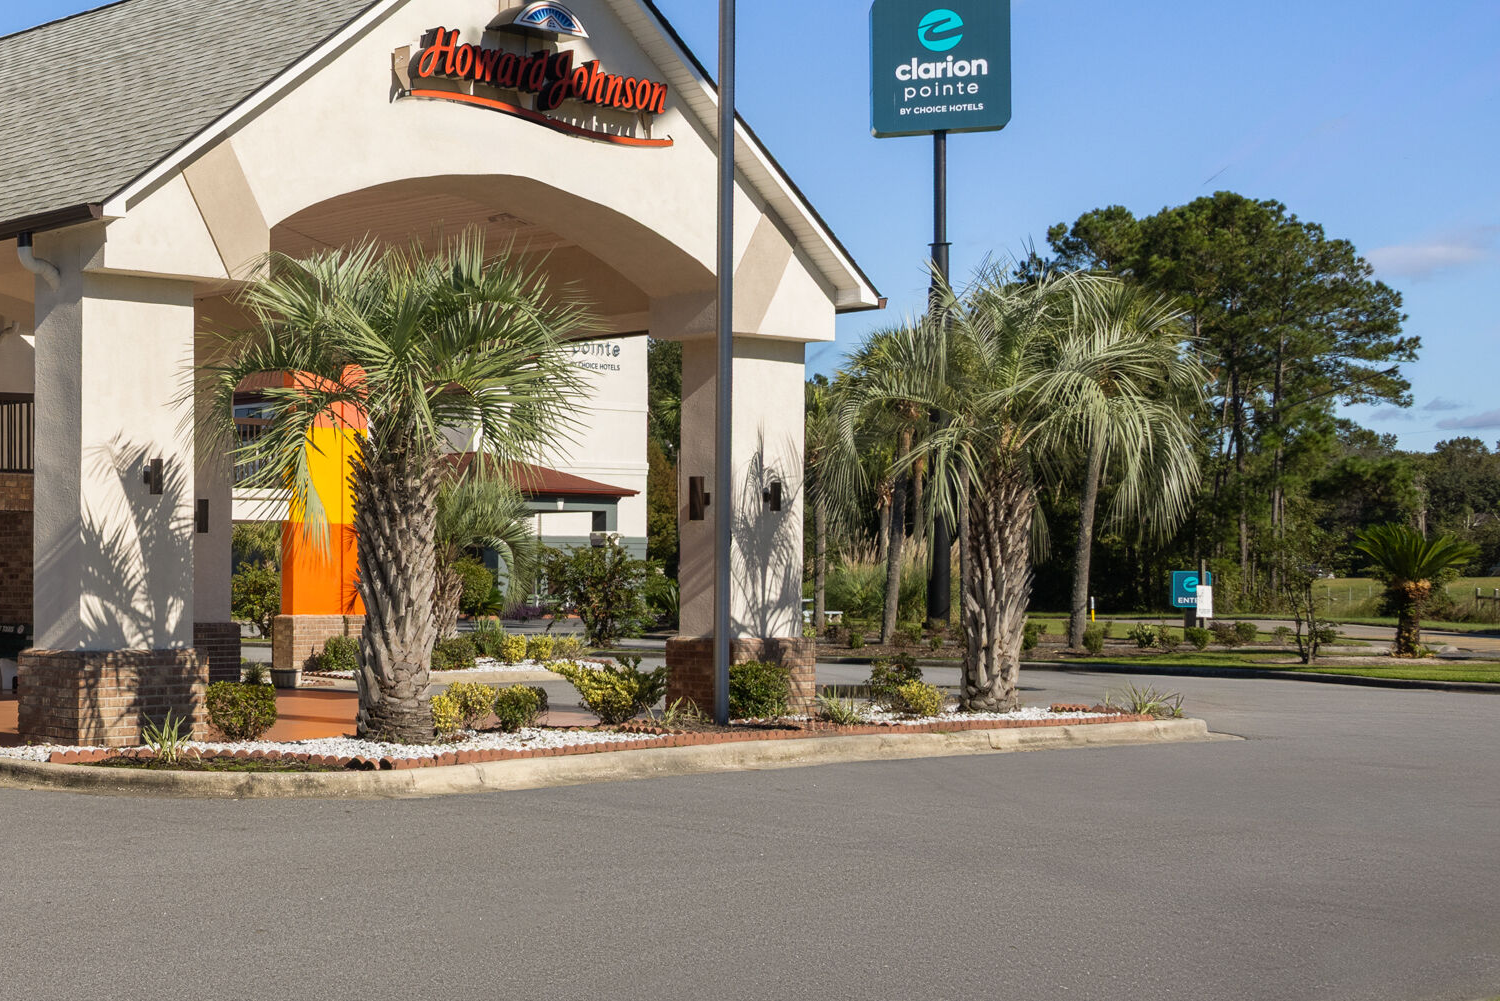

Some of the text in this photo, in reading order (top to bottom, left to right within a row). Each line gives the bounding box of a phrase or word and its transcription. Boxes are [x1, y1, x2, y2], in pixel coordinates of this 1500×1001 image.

[418, 26, 668, 114] Howard Johnson
[895, 55, 988, 81] clarion
[904, 81, 979, 102] pointe
[900, 103, 984, 115] BY CHOICE HOTELS
[600, 363, 620, 371] HOTELS
